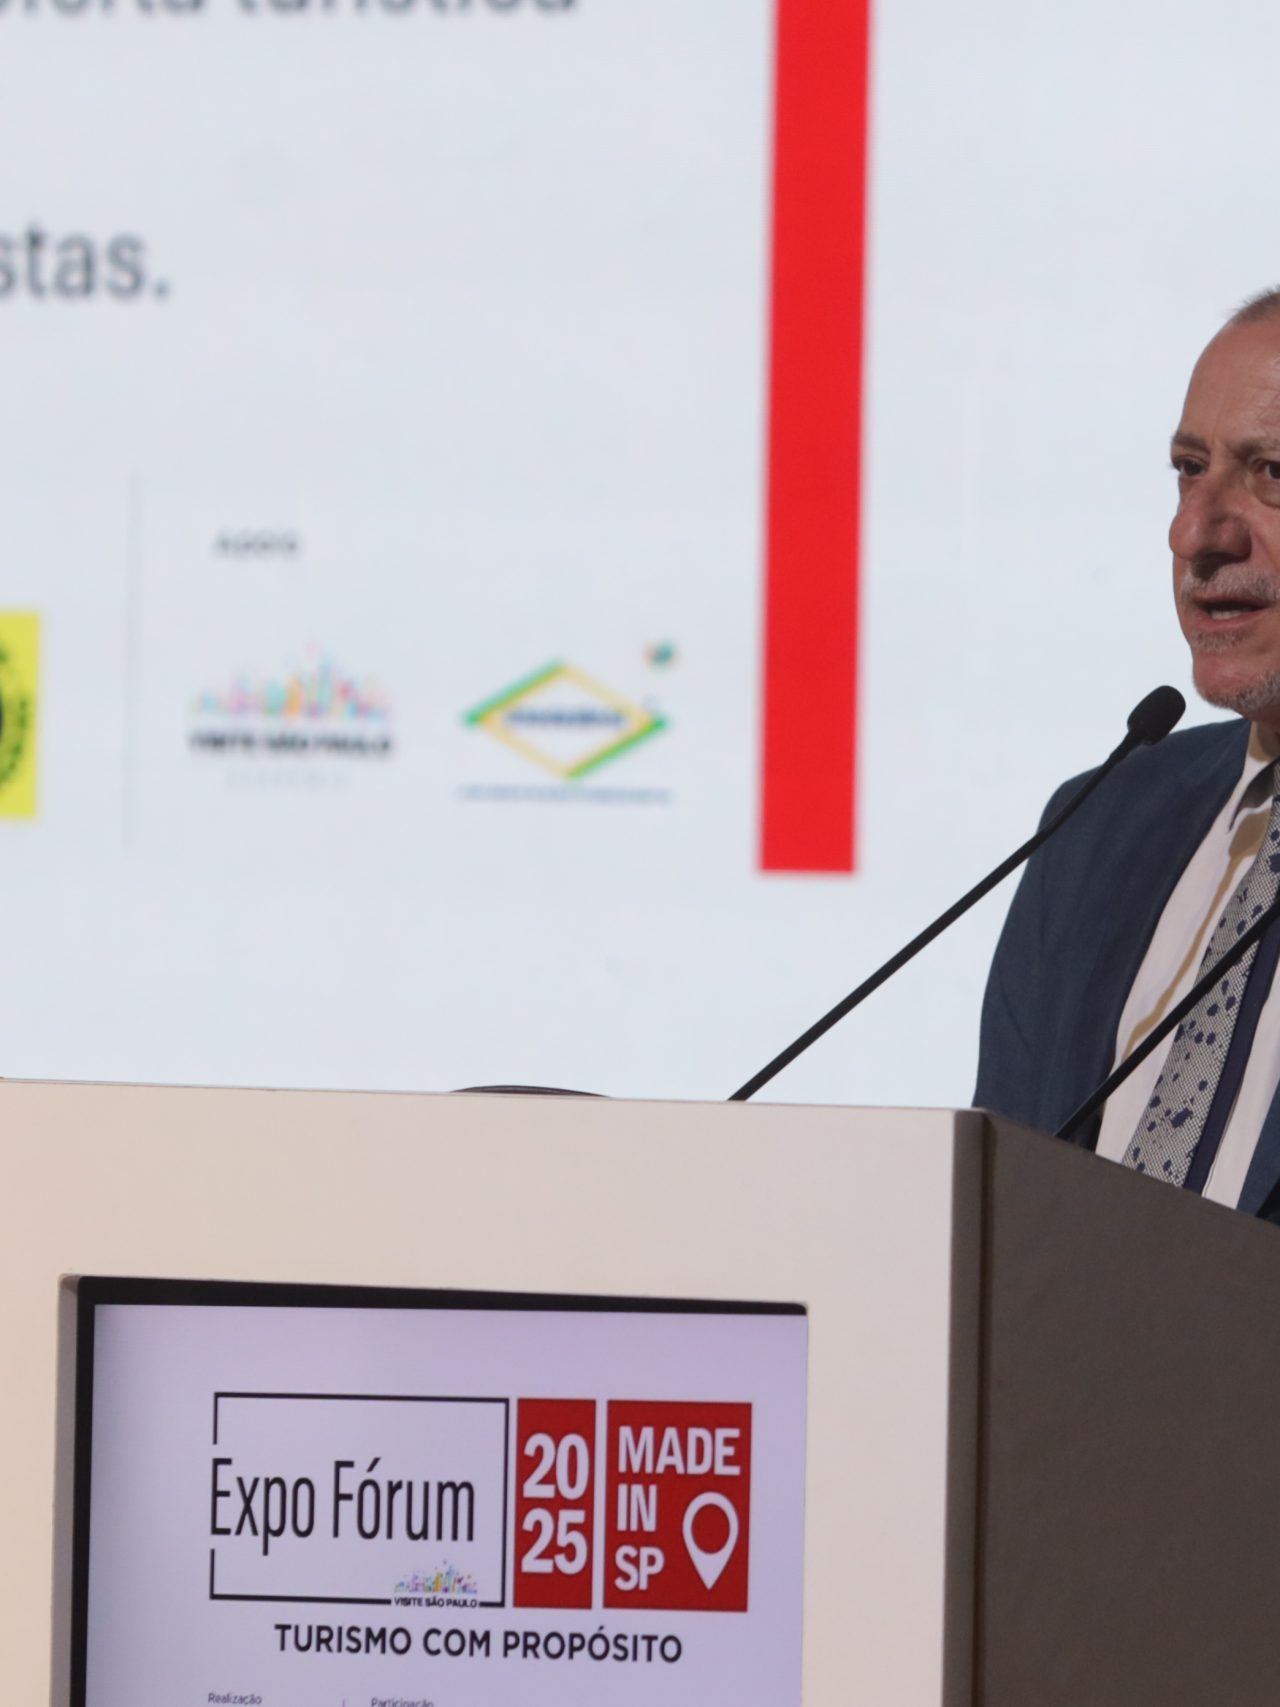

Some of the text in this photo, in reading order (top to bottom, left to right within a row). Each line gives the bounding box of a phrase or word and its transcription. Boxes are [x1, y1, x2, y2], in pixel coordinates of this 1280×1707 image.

[523, 1433, 589, 1499] 20
[617, 1426, 741, 1476] MADE
[210, 1457, 475, 1556] Expo Fórum
[616, 1484, 657, 1532] IN
[521, 1508, 588, 1574] 25
[614, 1545, 665, 1591] SP
[394, 1595, 477, 1609] VISITE SÃO PAULO
[274, 1623, 683, 1664] TURISMO COM PROPÓSITO
[207, 1692, 263, 1706] Realização
